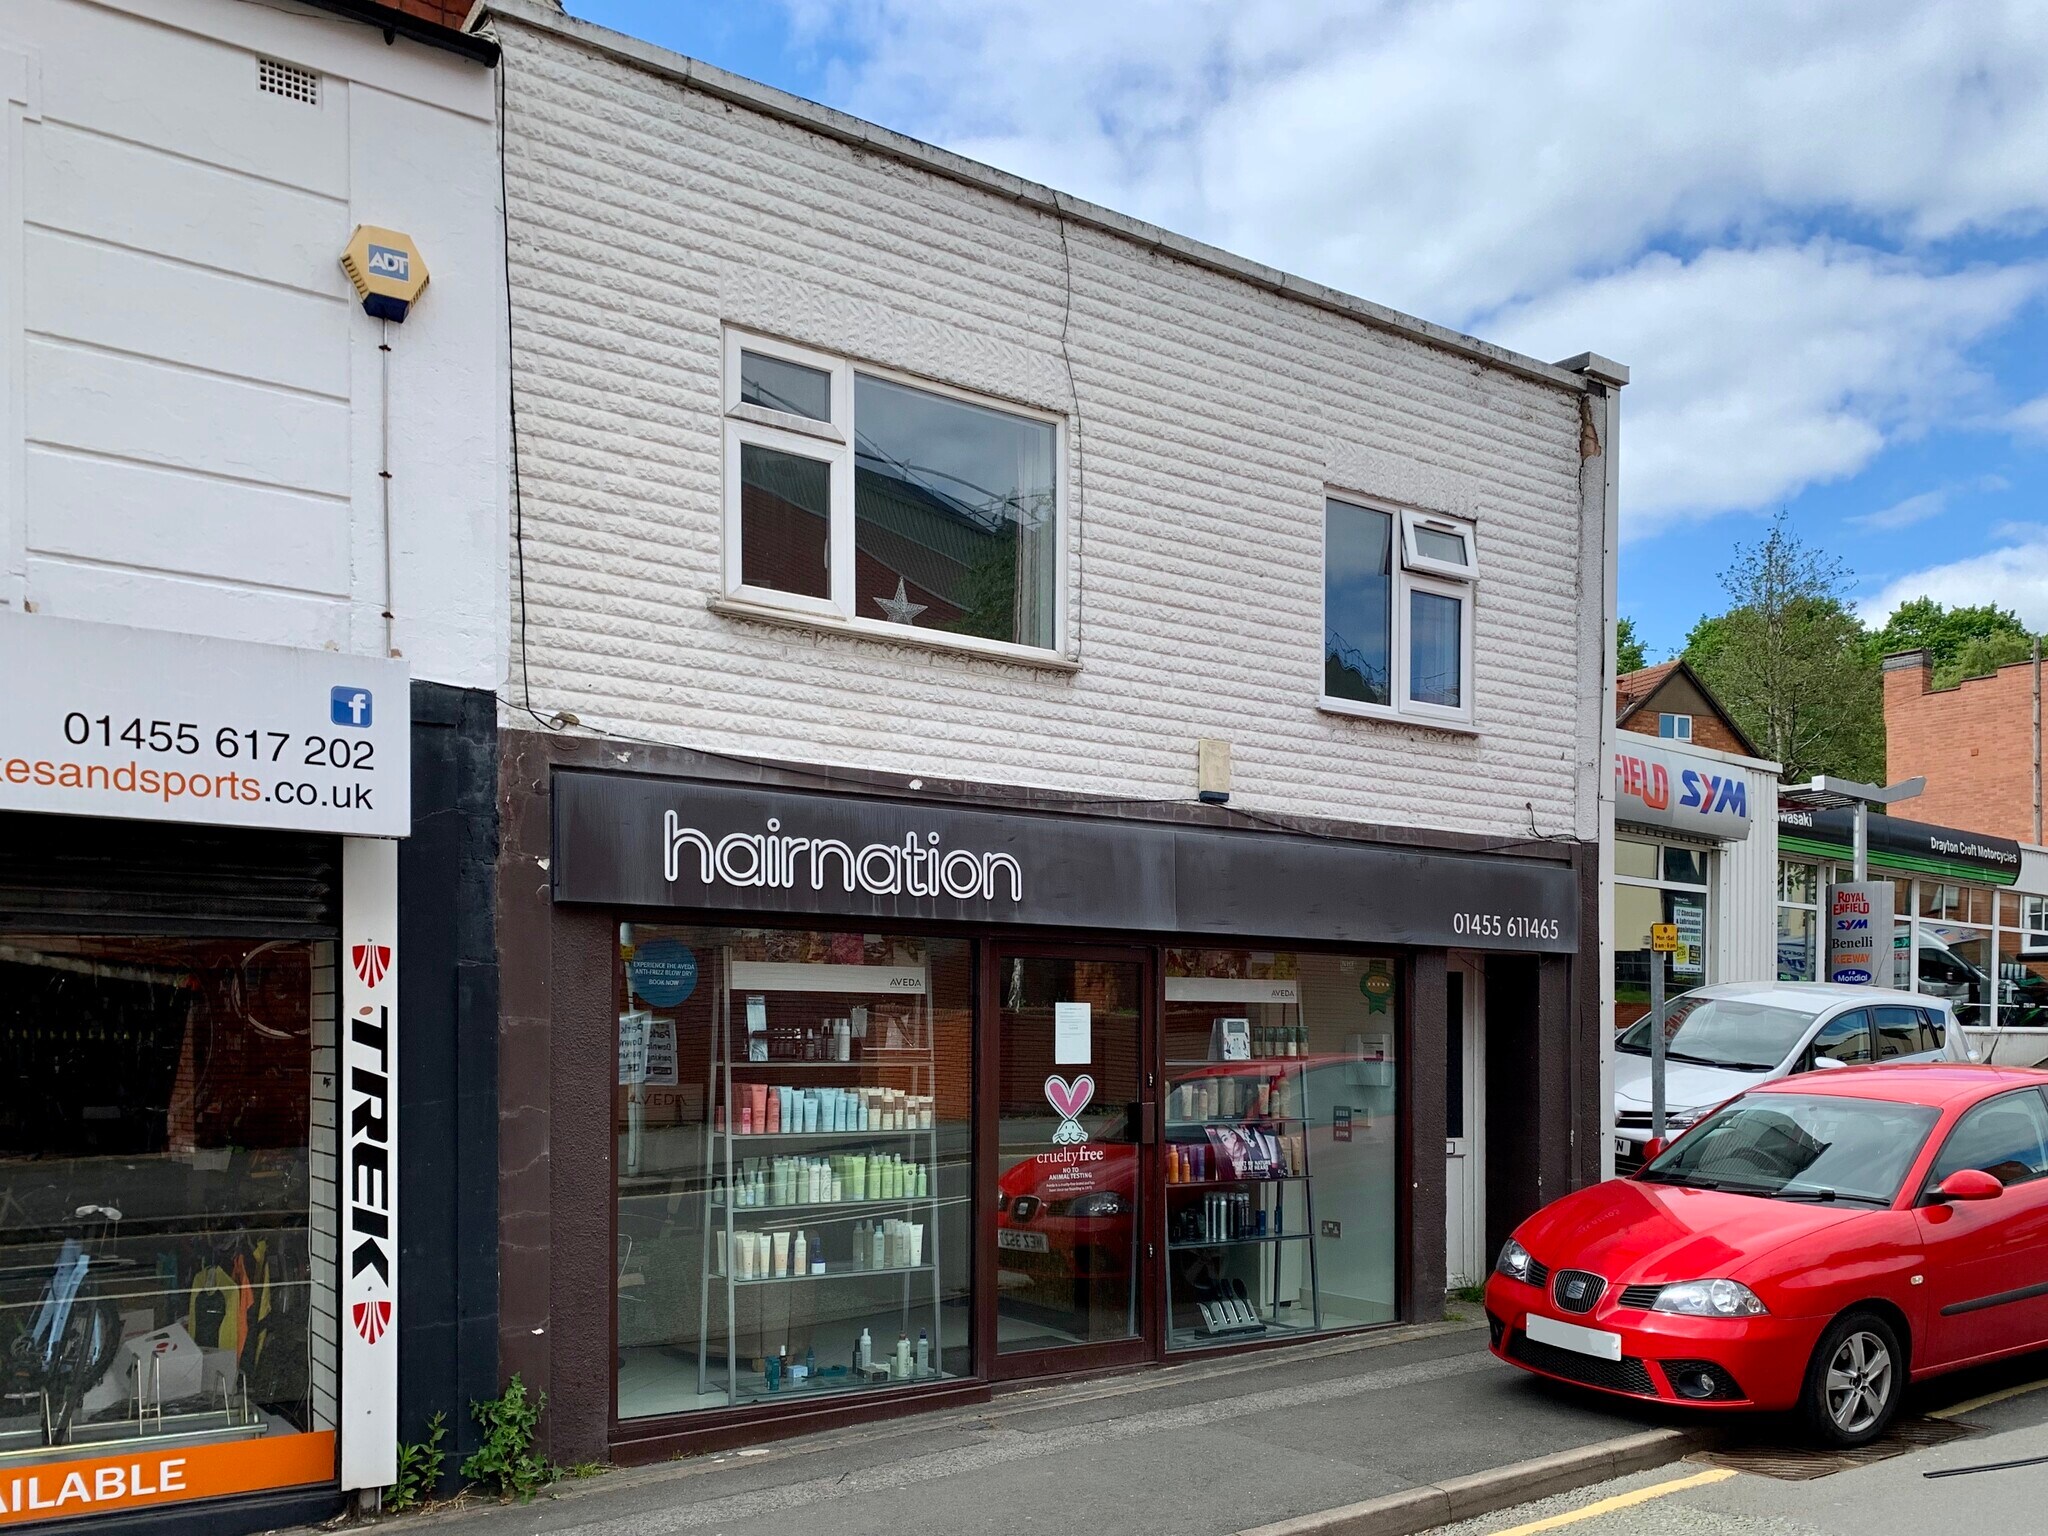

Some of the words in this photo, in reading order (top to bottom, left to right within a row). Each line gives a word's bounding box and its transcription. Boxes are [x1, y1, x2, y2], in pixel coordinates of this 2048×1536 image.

[369, 251, 408, 274] ADT
[64, 712, 200, 755] 01455
[215, 727, 291, 762] 617
[304, 735, 375, 771] 202
[0, 757, 374, 810] esandsports.co.uk
[1680, 769, 1746, 818] SYM
[1778, 812, 1813, 828] wasaki
[664, 809, 1022, 903] hairnation
[1930, 836, 1959, 855] Drayton
[1960, 841, 1977, 857] Croft
[1978, 844, 2018, 864] Motorcycles
[1837, 891, 1866, 904] ROYAL
[1833, 902, 1870, 916] ENFIELD
[1453, 912, 1501, 936] 01455
[1507, 916, 1559, 940] 611465
[1836, 919, 1868, 930] SYM
[1832, 936, 1873, 949] Benelli
[678, 963, 695, 971] AVEDA
[1833, 953, 1870, 965] KEEWAY
[890, 978, 922, 987] AVEDA
[1837, 973, 1868, 983] Mondial
[1271, 989, 1295, 997] AVEDA
[351, 1006, 389, 1288] TREK
[1036, 1146, 1079, 1167] cruelty
[1079, 1145, 1104, 1162] free
[1049, 1173, 1070, 1181] ANIMAL
[0, 1458, 187, 1514] ILABLE
